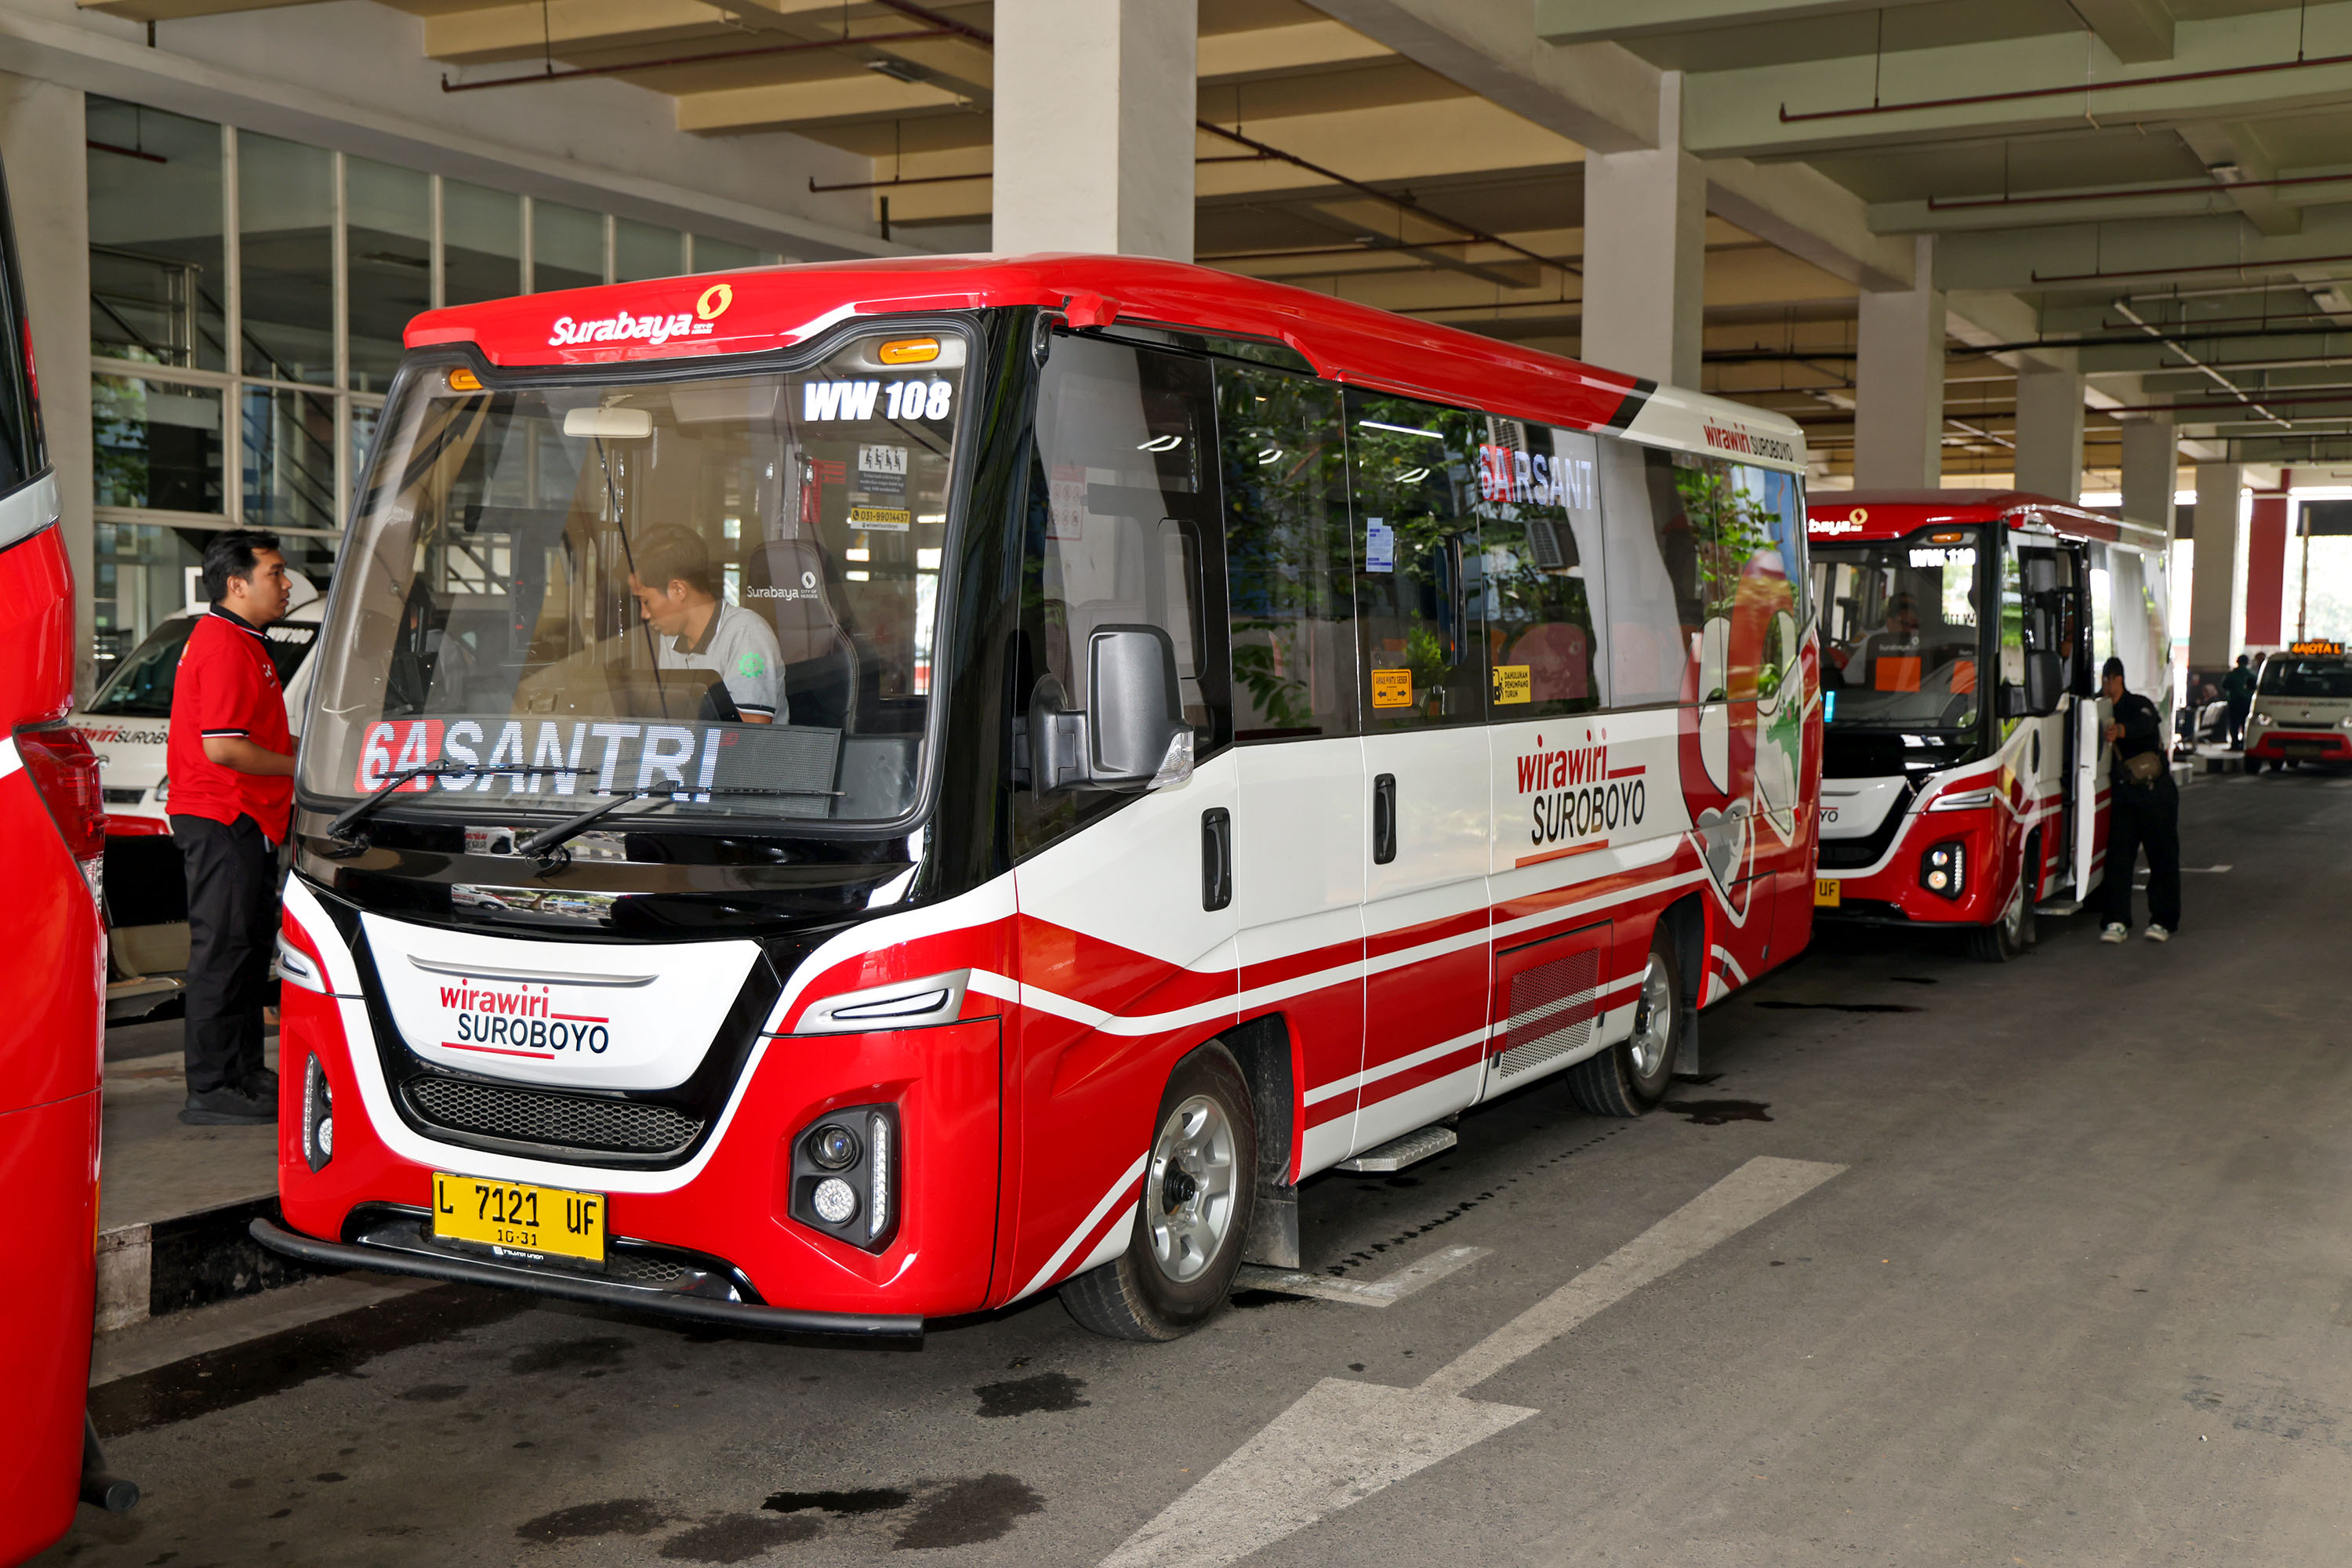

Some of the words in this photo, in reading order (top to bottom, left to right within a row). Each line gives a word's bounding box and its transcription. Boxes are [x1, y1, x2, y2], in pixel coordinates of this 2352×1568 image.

[549, 311, 693, 346] Surabaya
[804, 382, 880, 421] WW
[886, 381, 952, 420] 108
[1703, 416, 1751, 454] wirawiri
[1751, 435, 1793, 462] SUROBOYO
[1479, 446, 1512, 502] 6A
[1909, 549, 1945, 568] WW
[747, 586, 799, 601] Surabaya
[1504, 671, 1528, 680] DAHULUKAN
[1504, 680, 1529, 689] PENUMPANG
[362, 721, 427, 791] 6A
[437, 720, 722, 803] SANTRI
[1518, 727, 1607, 794] wirawiri
[1531, 779, 1646, 846] SUROBOYO
[1819, 881, 1836, 897] UF
[440, 978, 550, 1018] wirawiri
[457, 1013, 609, 1054] SUROBOYO
[438, 1179, 454, 1214] L
[475, 1184, 540, 1227] 7121
[566, 1196, 597, 1236] UF
